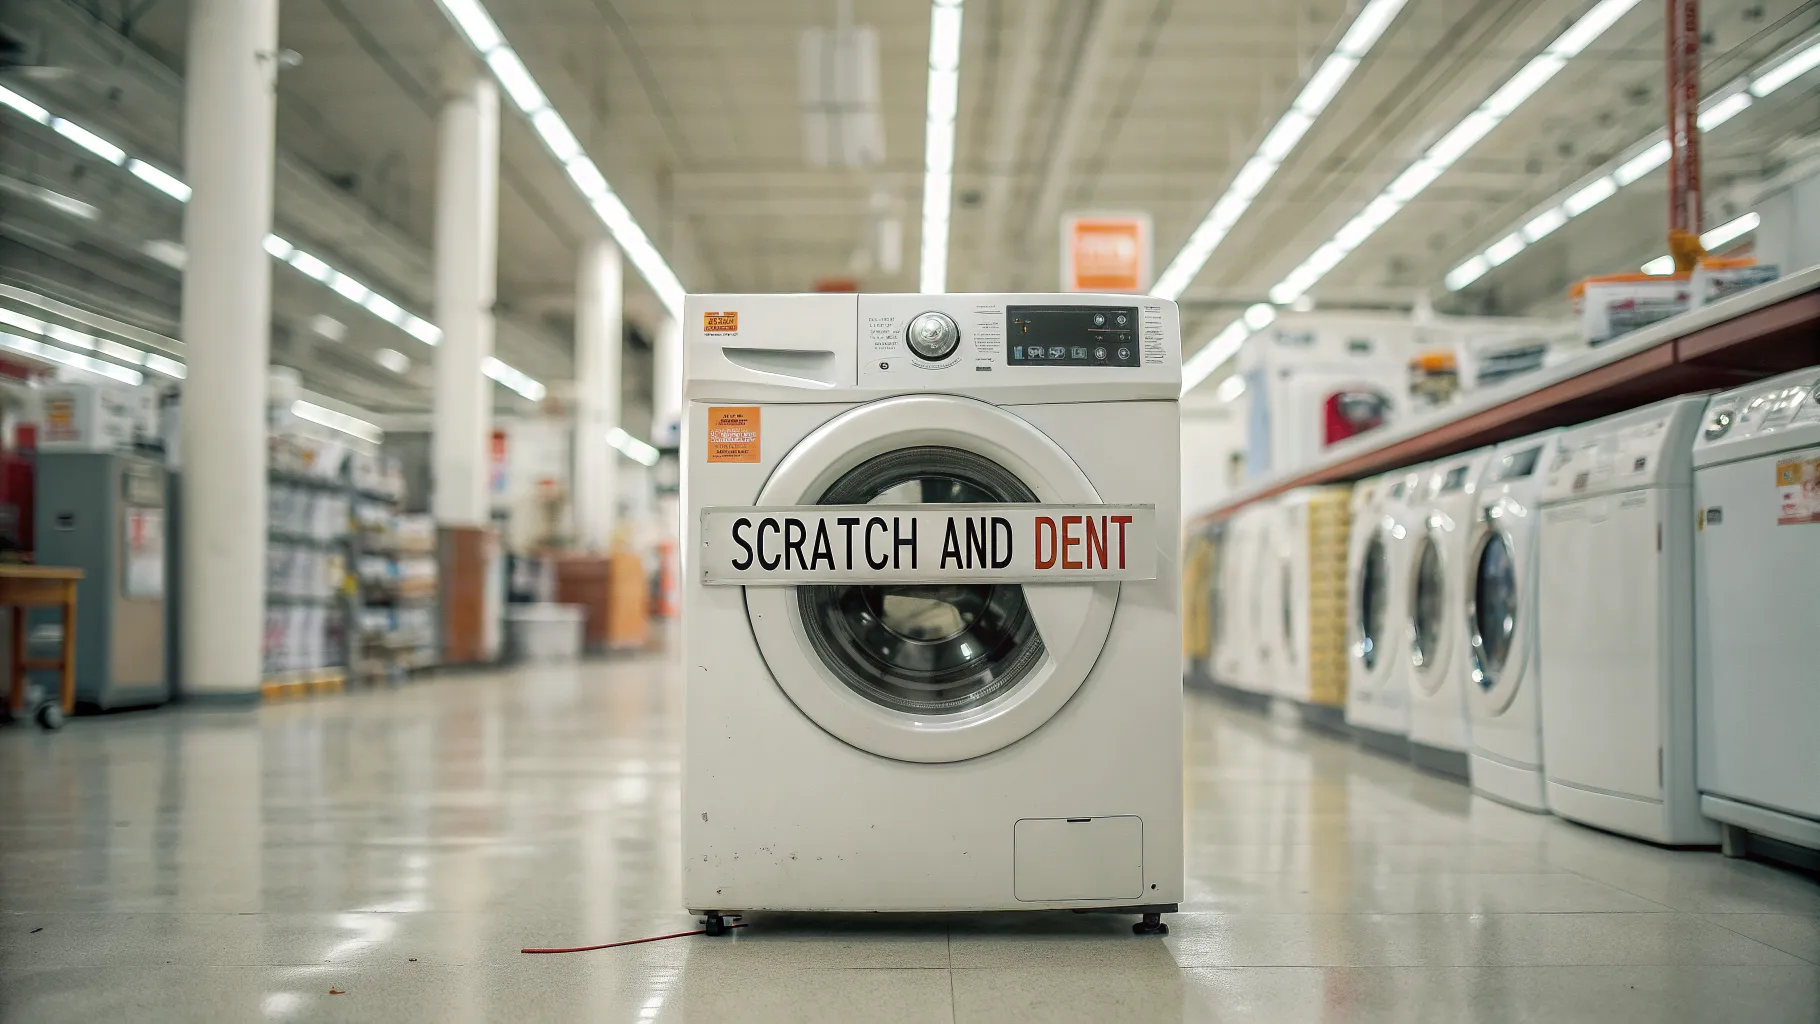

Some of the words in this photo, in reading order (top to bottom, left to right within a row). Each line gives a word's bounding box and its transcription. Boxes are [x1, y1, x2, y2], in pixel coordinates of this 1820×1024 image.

[732, 517, 917, 570] SCRATCH
[940, 517, 1012, 569] AND
[1035, 516, 1132, 569] DENT
